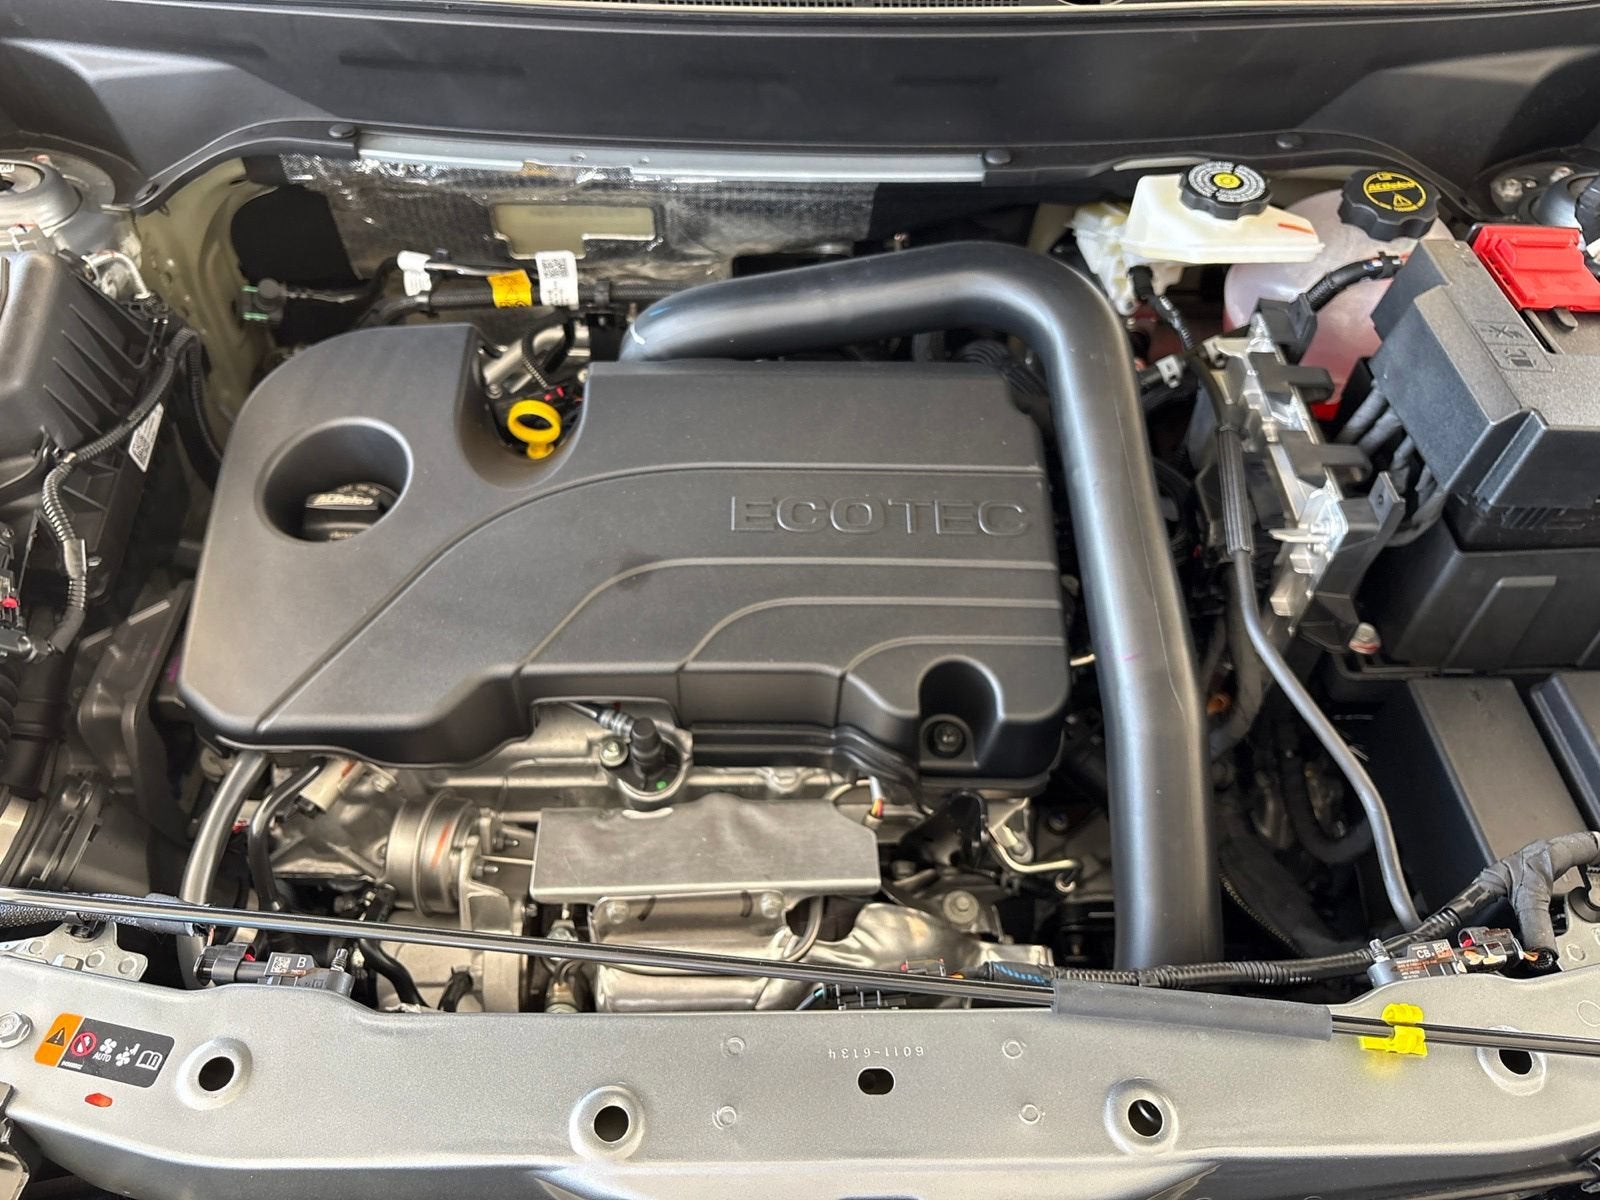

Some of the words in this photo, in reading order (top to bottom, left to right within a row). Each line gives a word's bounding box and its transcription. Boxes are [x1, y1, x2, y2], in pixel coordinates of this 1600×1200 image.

[730, 496, 1029, 536] ECOTEC
[296, 956, 307, 968] B
[92, 1052, 112, 1063] AUTO
[828, 1046, 924, 1060] 6011-6134
